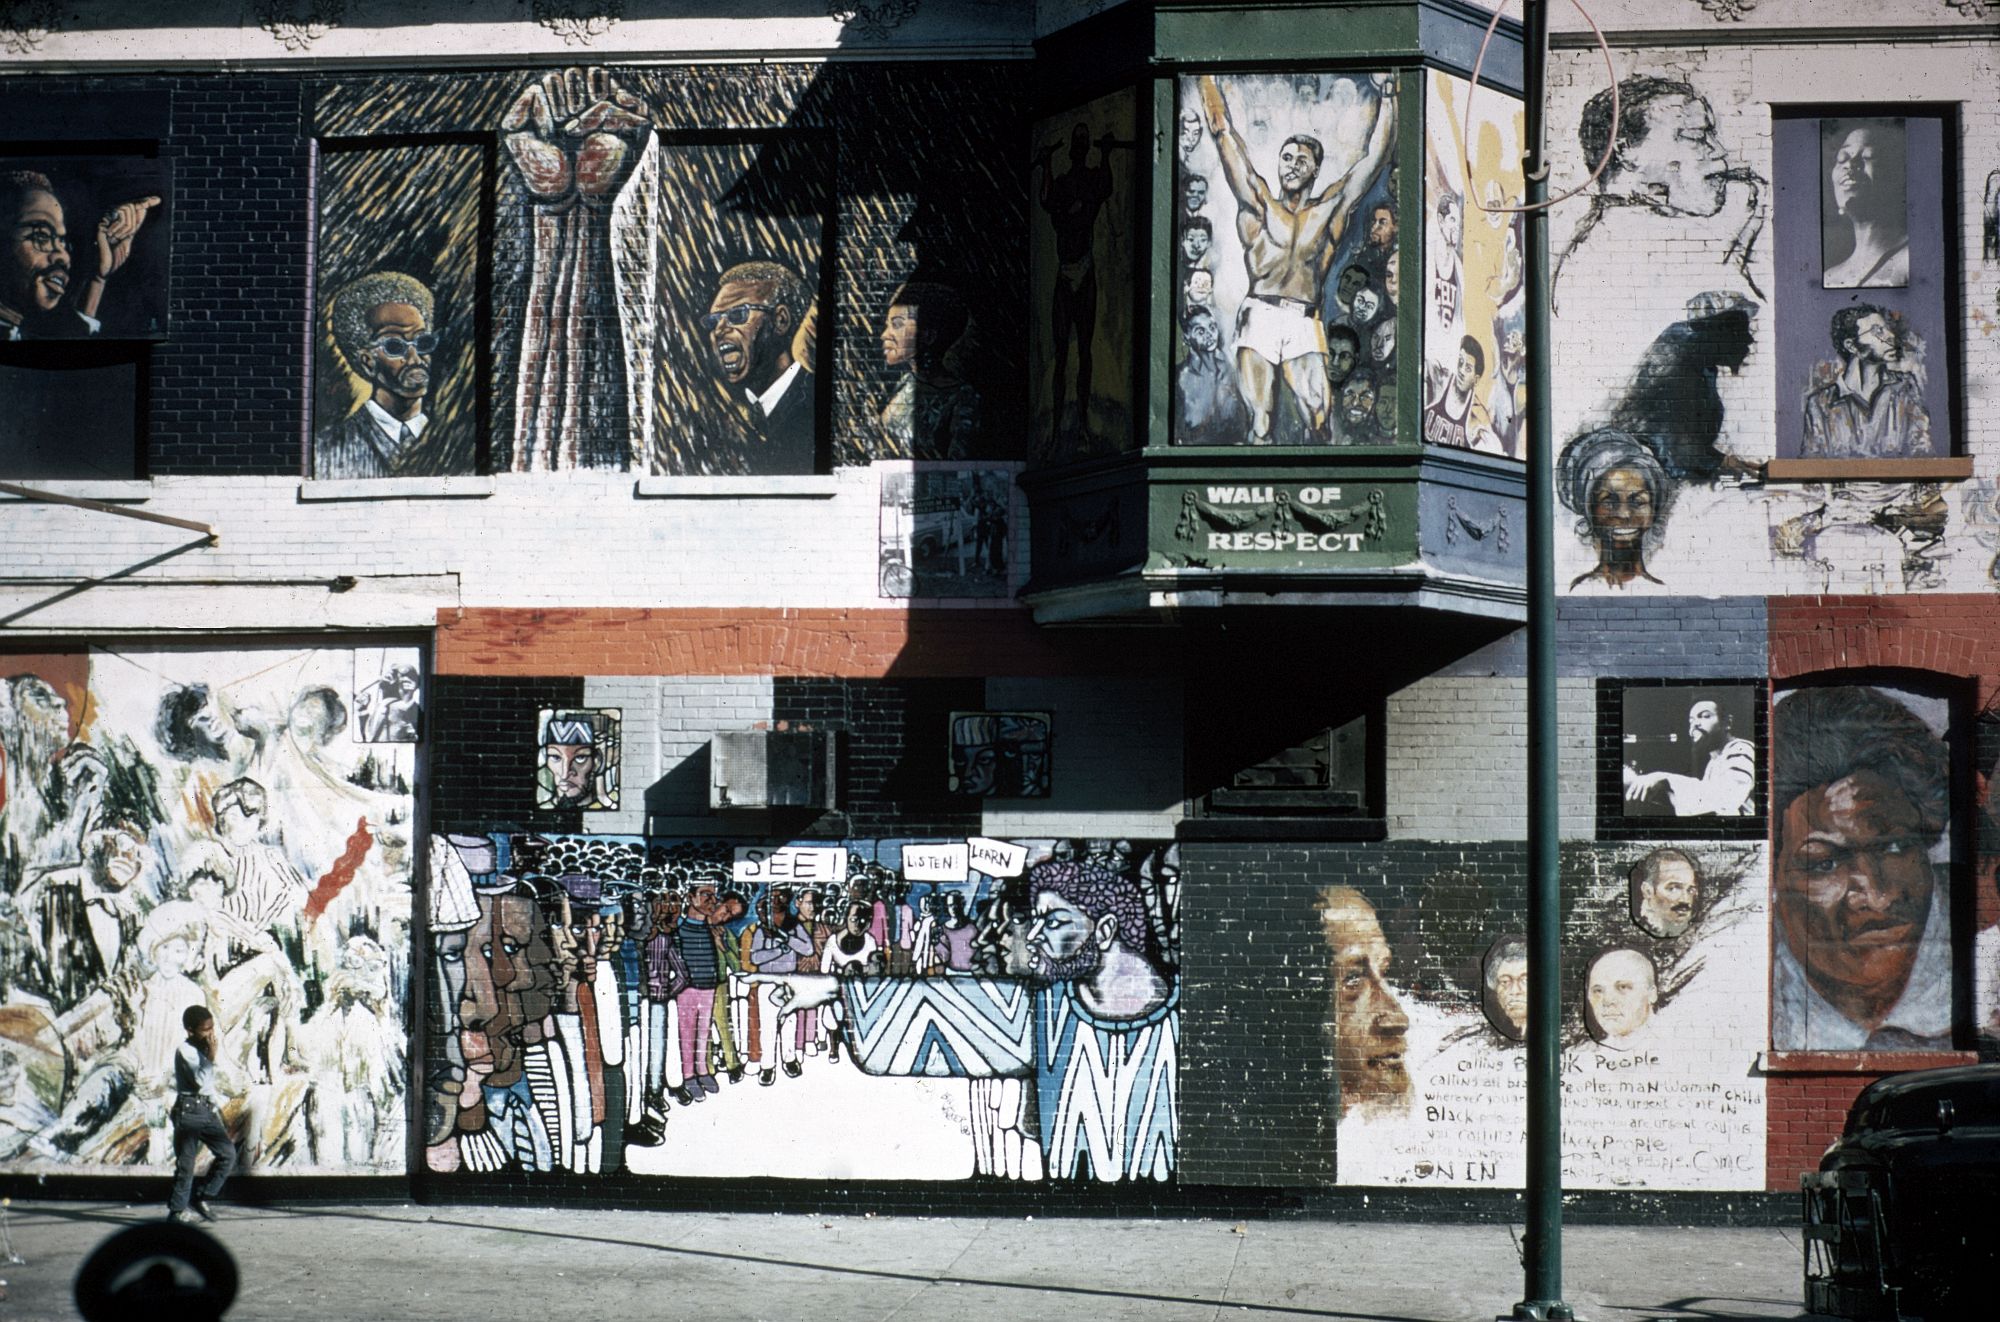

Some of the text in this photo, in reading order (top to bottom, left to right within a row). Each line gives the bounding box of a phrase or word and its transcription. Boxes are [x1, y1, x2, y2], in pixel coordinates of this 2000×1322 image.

[1299, 488, 1341, 504] OF
[1207, 532, 1364, 552] RESPECT
[971, 844, 1012, 868] LEARN
[1594, 1050, 1661, 1072] People
[1426, 1105, 1474, 1124] Black
[1465, 1160, 1497, 1182] IN
